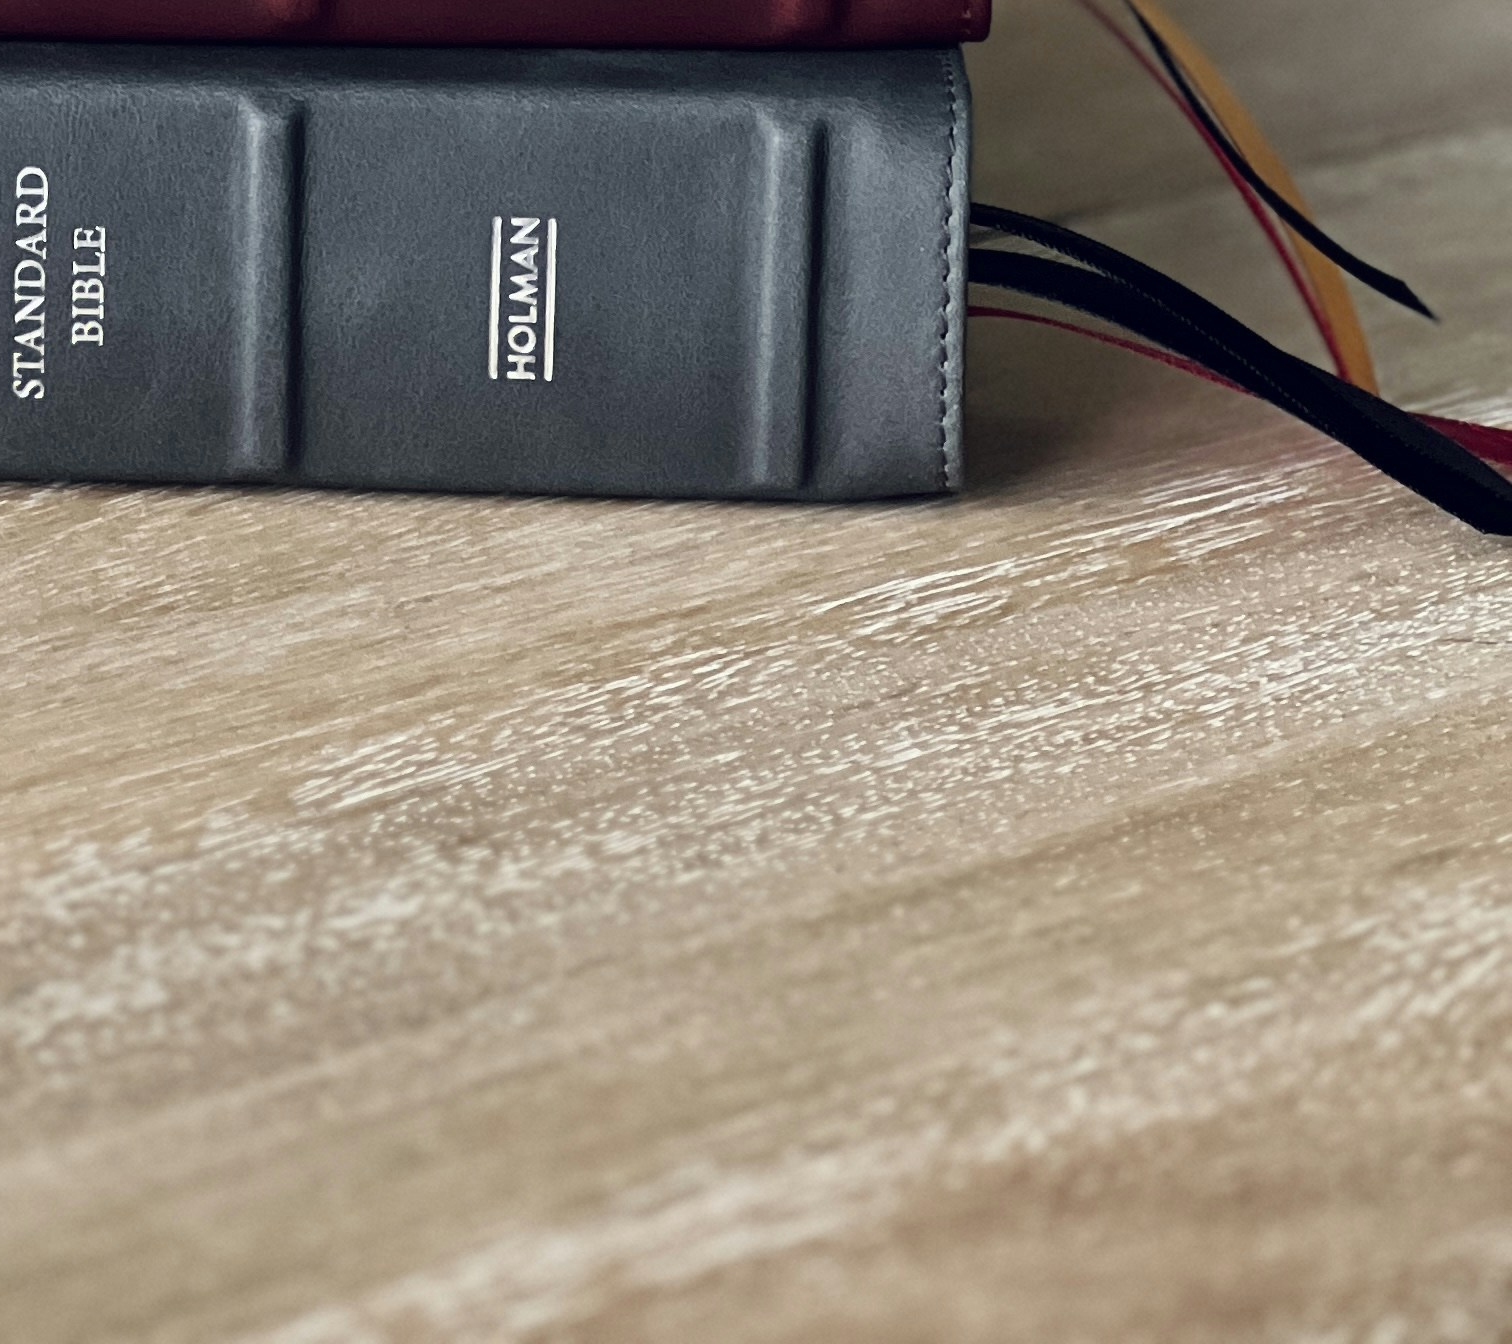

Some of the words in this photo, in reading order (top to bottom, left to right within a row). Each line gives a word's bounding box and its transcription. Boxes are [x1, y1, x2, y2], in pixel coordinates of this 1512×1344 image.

[13, 167, 48, 399] STANDARD
[72, 226, 105, 346] BIBLE
[507, 217, 540, 380] HOLMAN
